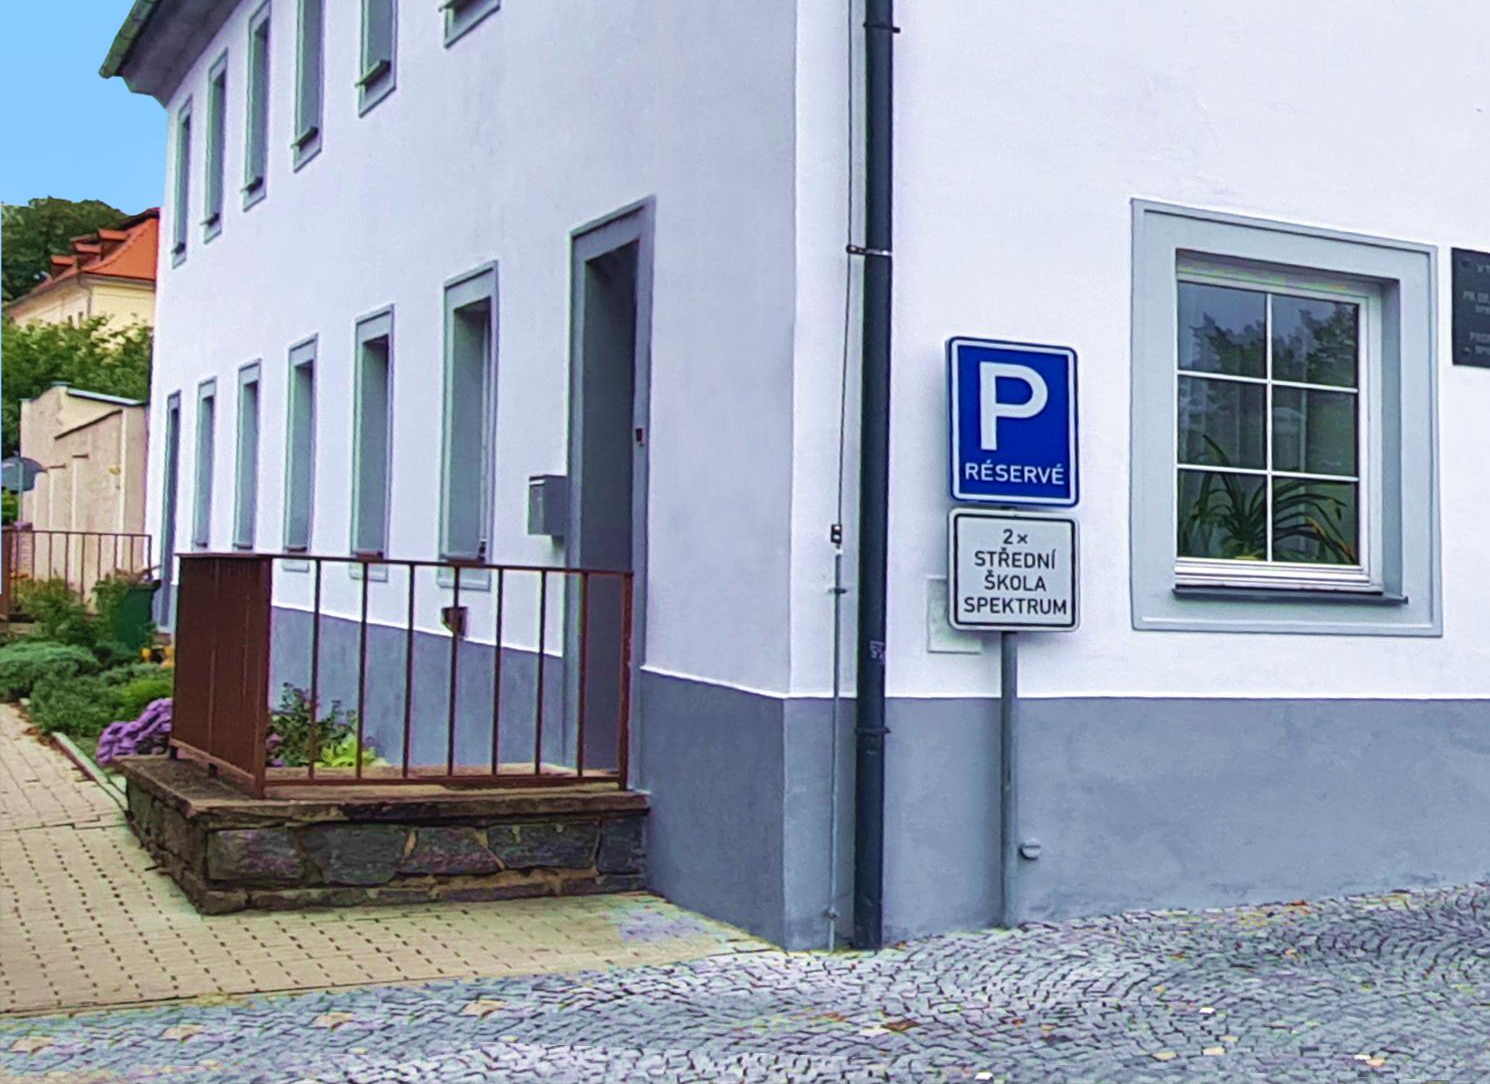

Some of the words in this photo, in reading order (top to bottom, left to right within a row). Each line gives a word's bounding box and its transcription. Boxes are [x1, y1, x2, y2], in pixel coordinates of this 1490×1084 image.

[979, 361, 1049, 451] P
[964, 459, 1065, 486] RÉSERVÉ
[974, 546, 1057, 571] STŘEDNÍ
[984, 569, 1047, 592] ŠKOLA
[963, 596, 1067, 616] SPEKTRUM
